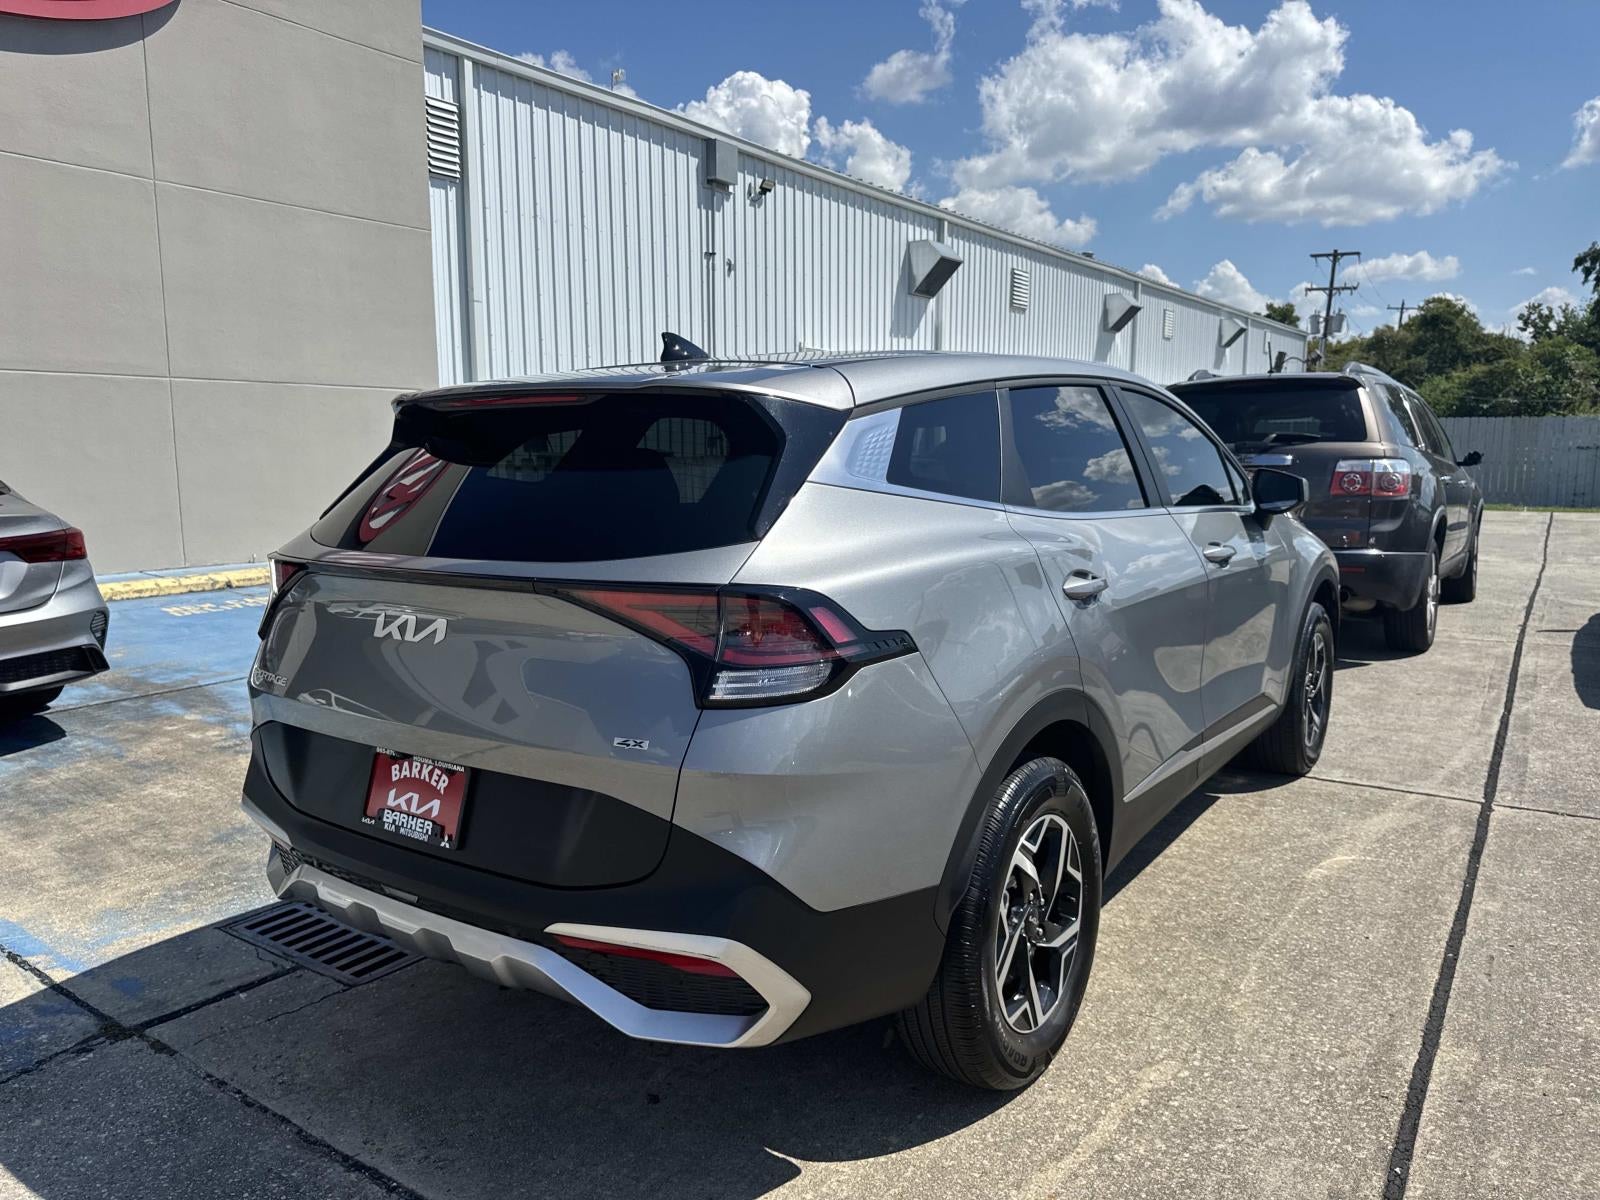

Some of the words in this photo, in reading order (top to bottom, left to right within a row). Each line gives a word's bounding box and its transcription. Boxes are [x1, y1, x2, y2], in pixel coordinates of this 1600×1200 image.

[373, 612, 448, 645] KIA
[391, 761, 449, 795] BARKER
[386, 788, 441, 818] KIA
[384, 822, 396, 832] KIA
[399, 827, 429, 842] MITSUBISHI
